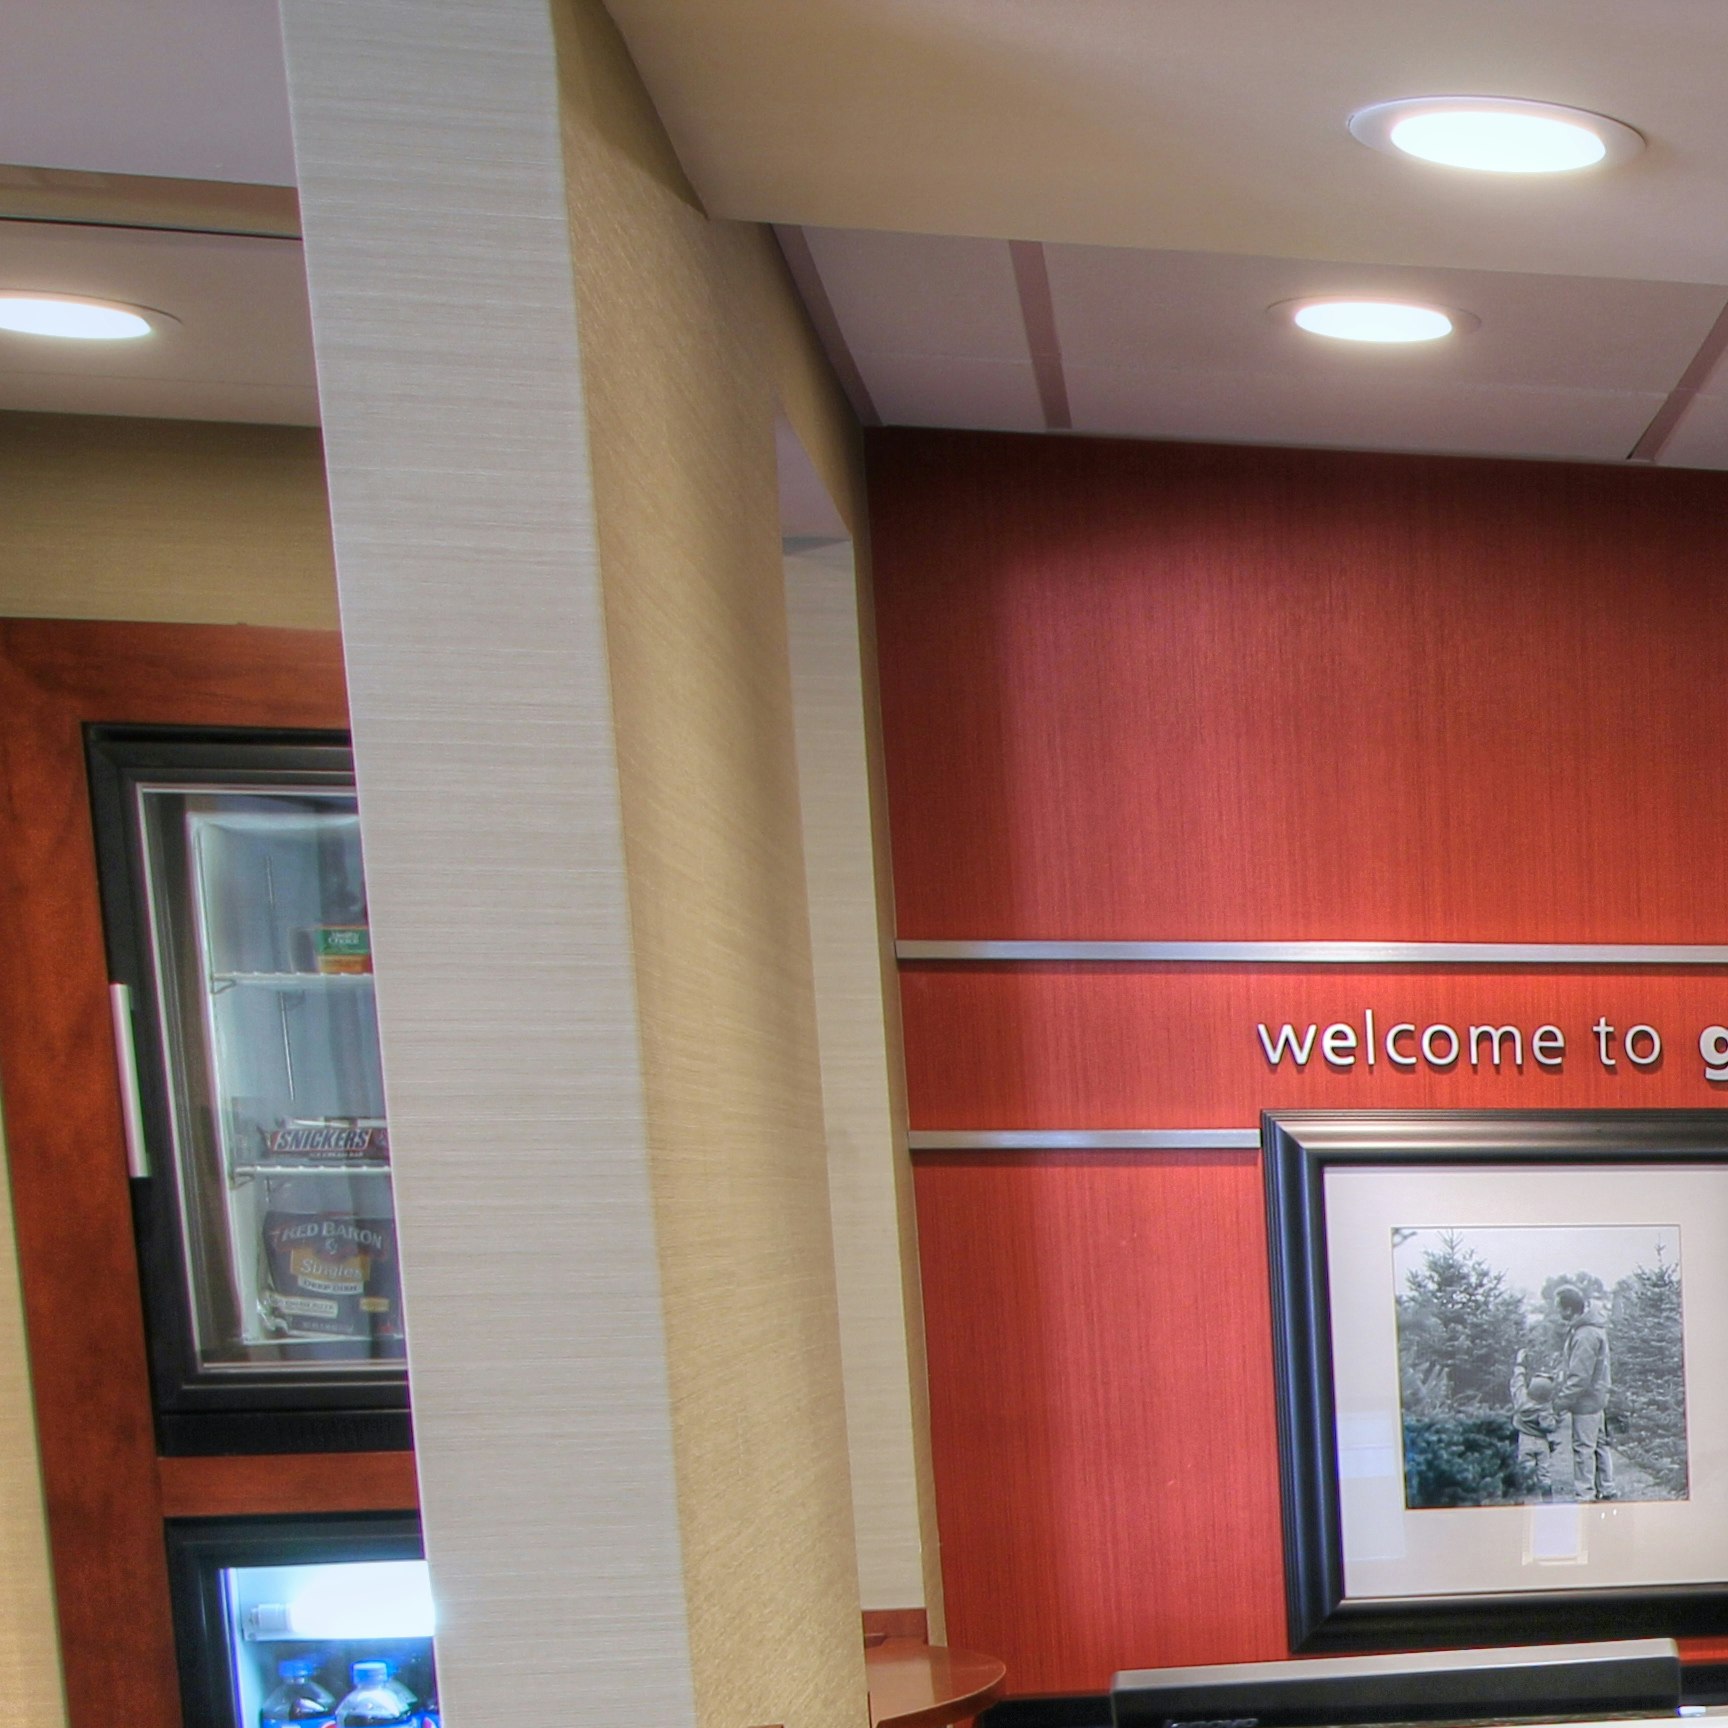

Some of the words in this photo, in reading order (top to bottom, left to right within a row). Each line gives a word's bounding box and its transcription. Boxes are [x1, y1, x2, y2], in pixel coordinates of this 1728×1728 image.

[1257, 1008, 1566, 1067] welcome
[1593, 1017, 1662, 1066] to
[276, 1129, 372, 1150] SNICKERS
[281, 1223, 319, 1242] RED
[322, 1221, 383, 1249] BARON
